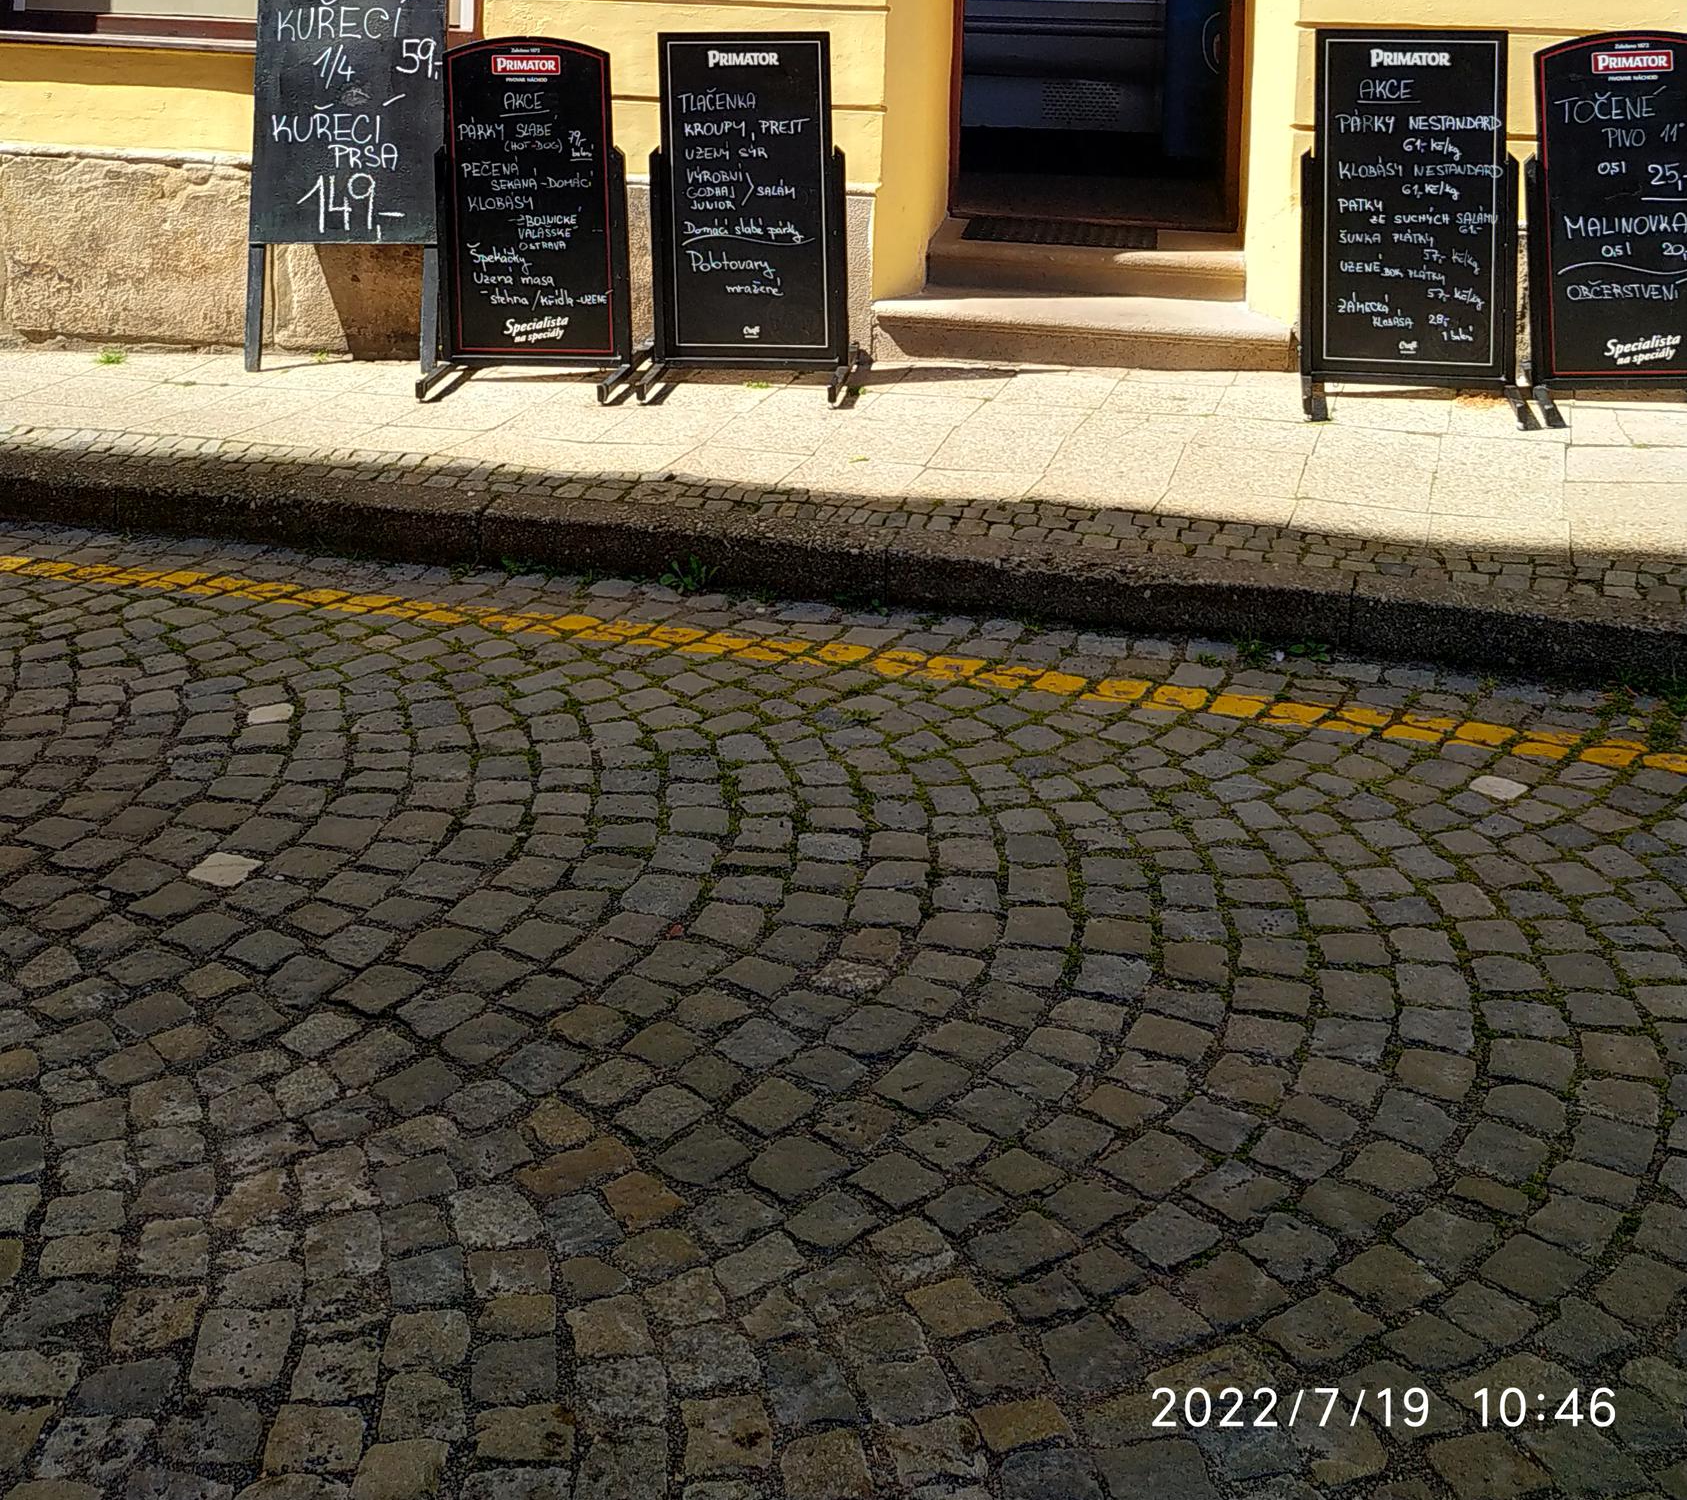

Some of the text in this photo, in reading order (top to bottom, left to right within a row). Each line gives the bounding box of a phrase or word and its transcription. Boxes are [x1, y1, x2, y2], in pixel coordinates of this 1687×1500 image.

[312, 44, 356, 89] 1/4
[496, 57, 557, 71] PRIMATOR
[707, 50, 780, 68] PRIMATOR
[1370, 49, 1452, 68] PRIMATOR
[1597, 54, 1668, 70] PRIMATOR
[1359, 79, 1415, 99] AKCE
[503, 91, 545, 110] AKCE
[677, 87, 757, 114] TLAČENKA
[1553, 85, 1667, 124] TOČENÉ
[271, 92, 406, 144] KUŘECÍ
[1335, 108, 1502, 134] PÁRKY NESTANDARD
[458, 116, 505, 141] PÁRKY
[1601, 127, 1646, 148] PIVO
[328, 143, 399, 171] PRSA
[738, 143, 768, 159] SÝR
[461, 155, 520, 178] PEČENÁ
[686, 162, 743, 184] VÝROBNÍ
[1337, 155, 1504, 179] KLOBÁSY NESTANDARD
[490, 167, 538, 191] SEKANÁ
[756, 179, 796, 199] SALÁM
[467, 191, 534, 212] KLOBÁSY
[690, 199, 736, 210] JUNIOR
[1337, 198, 1383, 213] PATKY
[1393, 206, 1450, 225] SUCHÝCH
[1563, 211, 1687, 239] MALINOVKA
[683, 218, 729, 236] Domácí
[1338, 229, 1382, 244] ŠUNKA
[519, 241, 567, 251] OSTRAVA
[521, 275, 556, 287] masa
[1566, 277, 1687, 301] OBČERSTVENÍ
[503, 316, 569, 336] Specialista
[514, 334, 526, 343] na
[1604, 334, 1682, 359] Specialista
[1616, 355, 1631, 366] na
